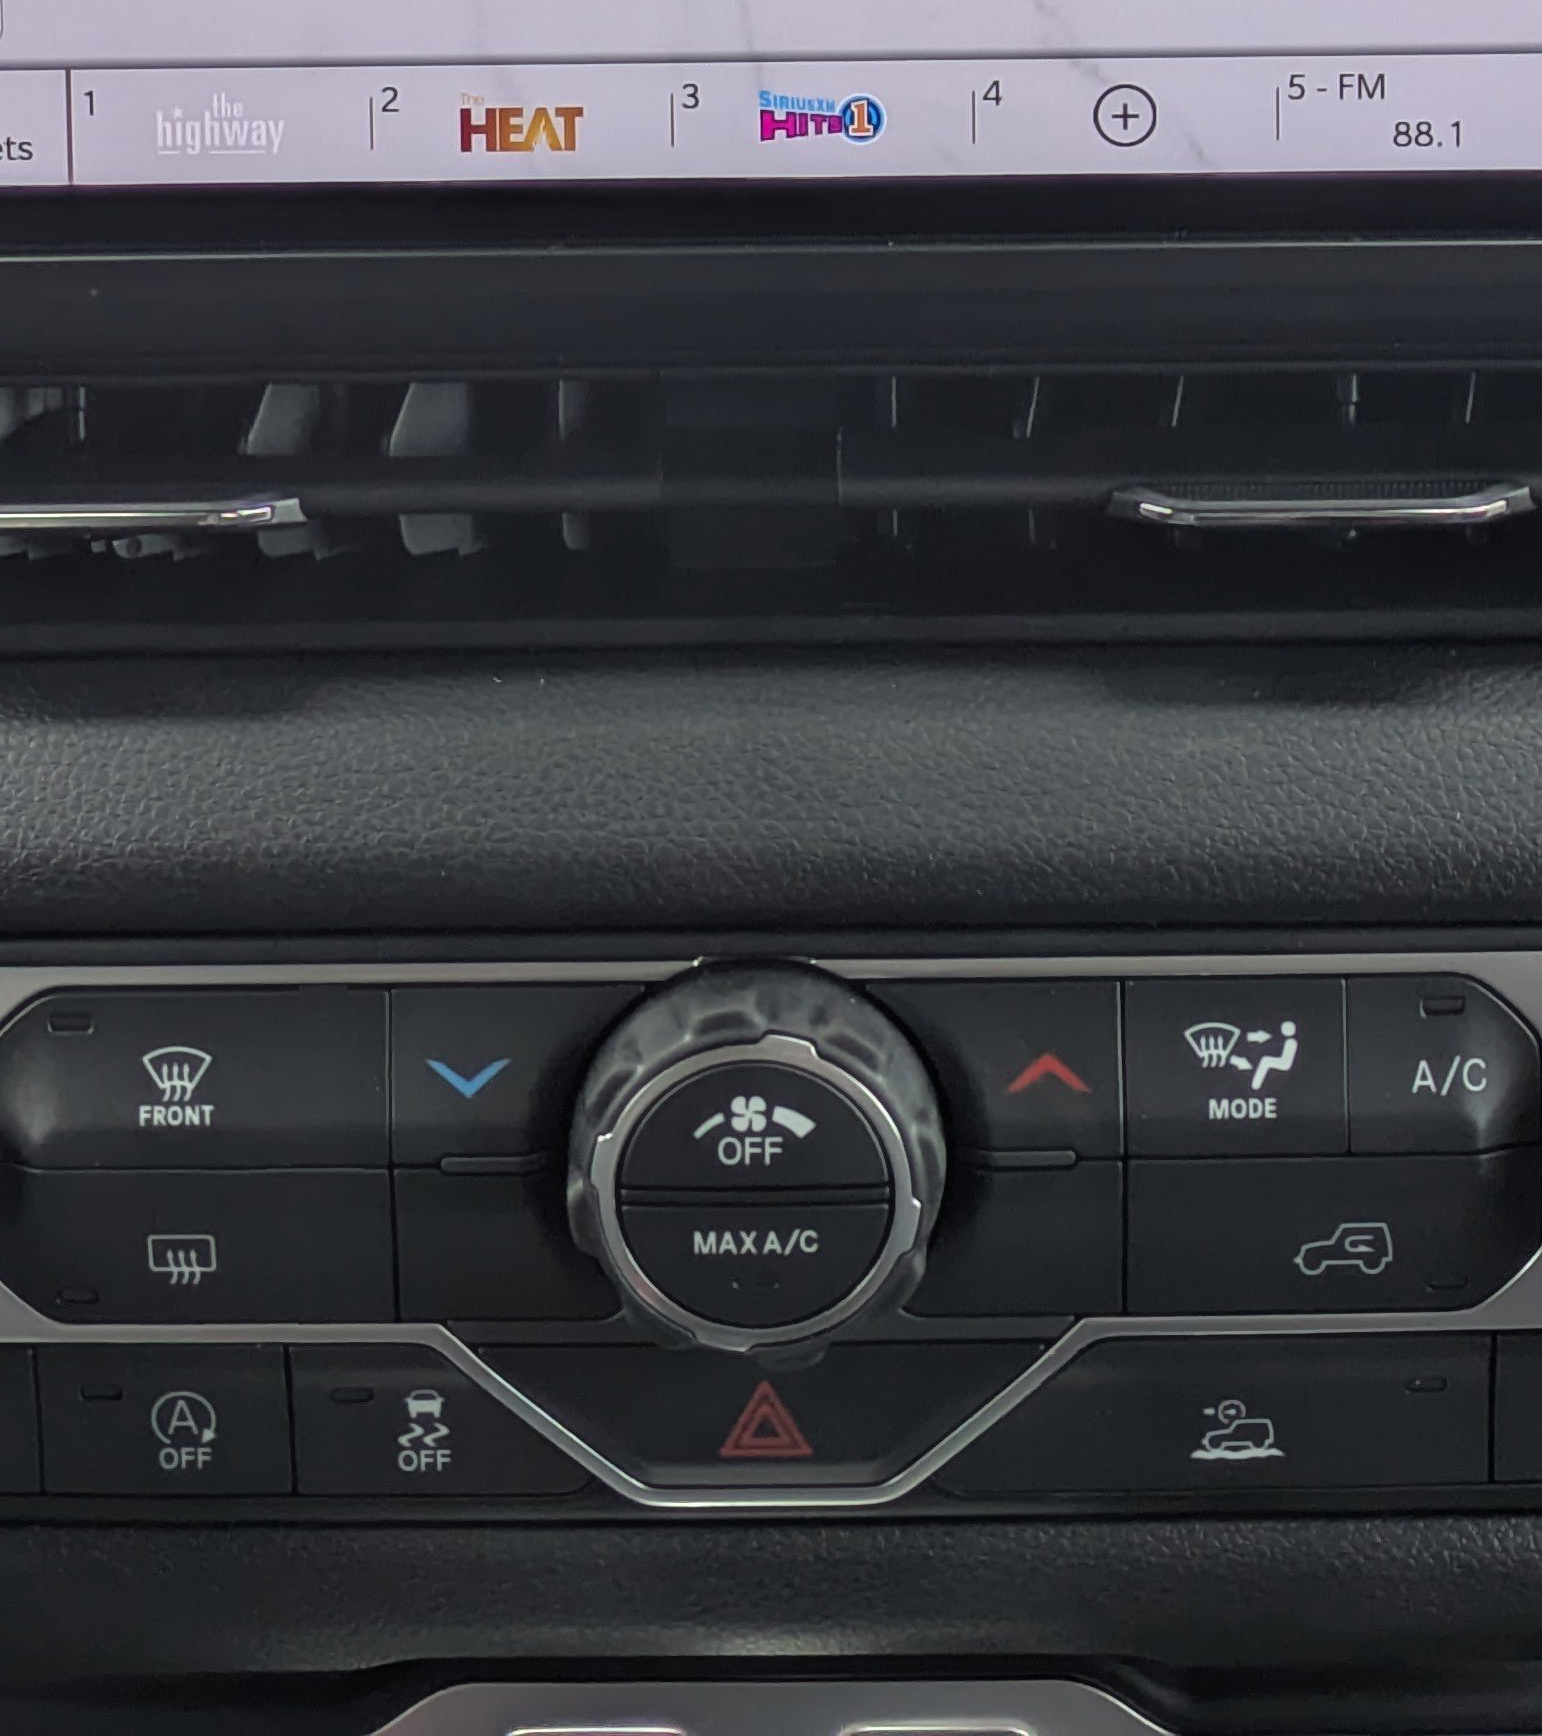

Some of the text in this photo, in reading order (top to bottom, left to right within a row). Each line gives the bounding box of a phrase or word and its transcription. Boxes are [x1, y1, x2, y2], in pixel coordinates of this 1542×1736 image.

[382, 86, 400, 113] 2
[681, 84, 700, 110] 3
[983, 81, 1003, 107] 4
[1288, 74, 1306, 101] 5
[1339, 74, 1385, 101] FM
[84, 91, 95, 116] 1
[212, 92, 243, 117] the
[156, 106, 285, 154] highway
[459, 106, 584, 152] HEAT
[1393, 120, 1461, 148] 88.1
[1412, 1058, 1488, 1096] A/C
[139, 1104, 214, 1127] FRONT
[1208, 1098, 1277, 1120] MODE
[718, 1136, 783, 1166] OFF
[693, 1228, 819, 1256] MAX A/C
[159, 1447, 212, 1470] OFF
[398, 1450, 452, 1472] OFF
